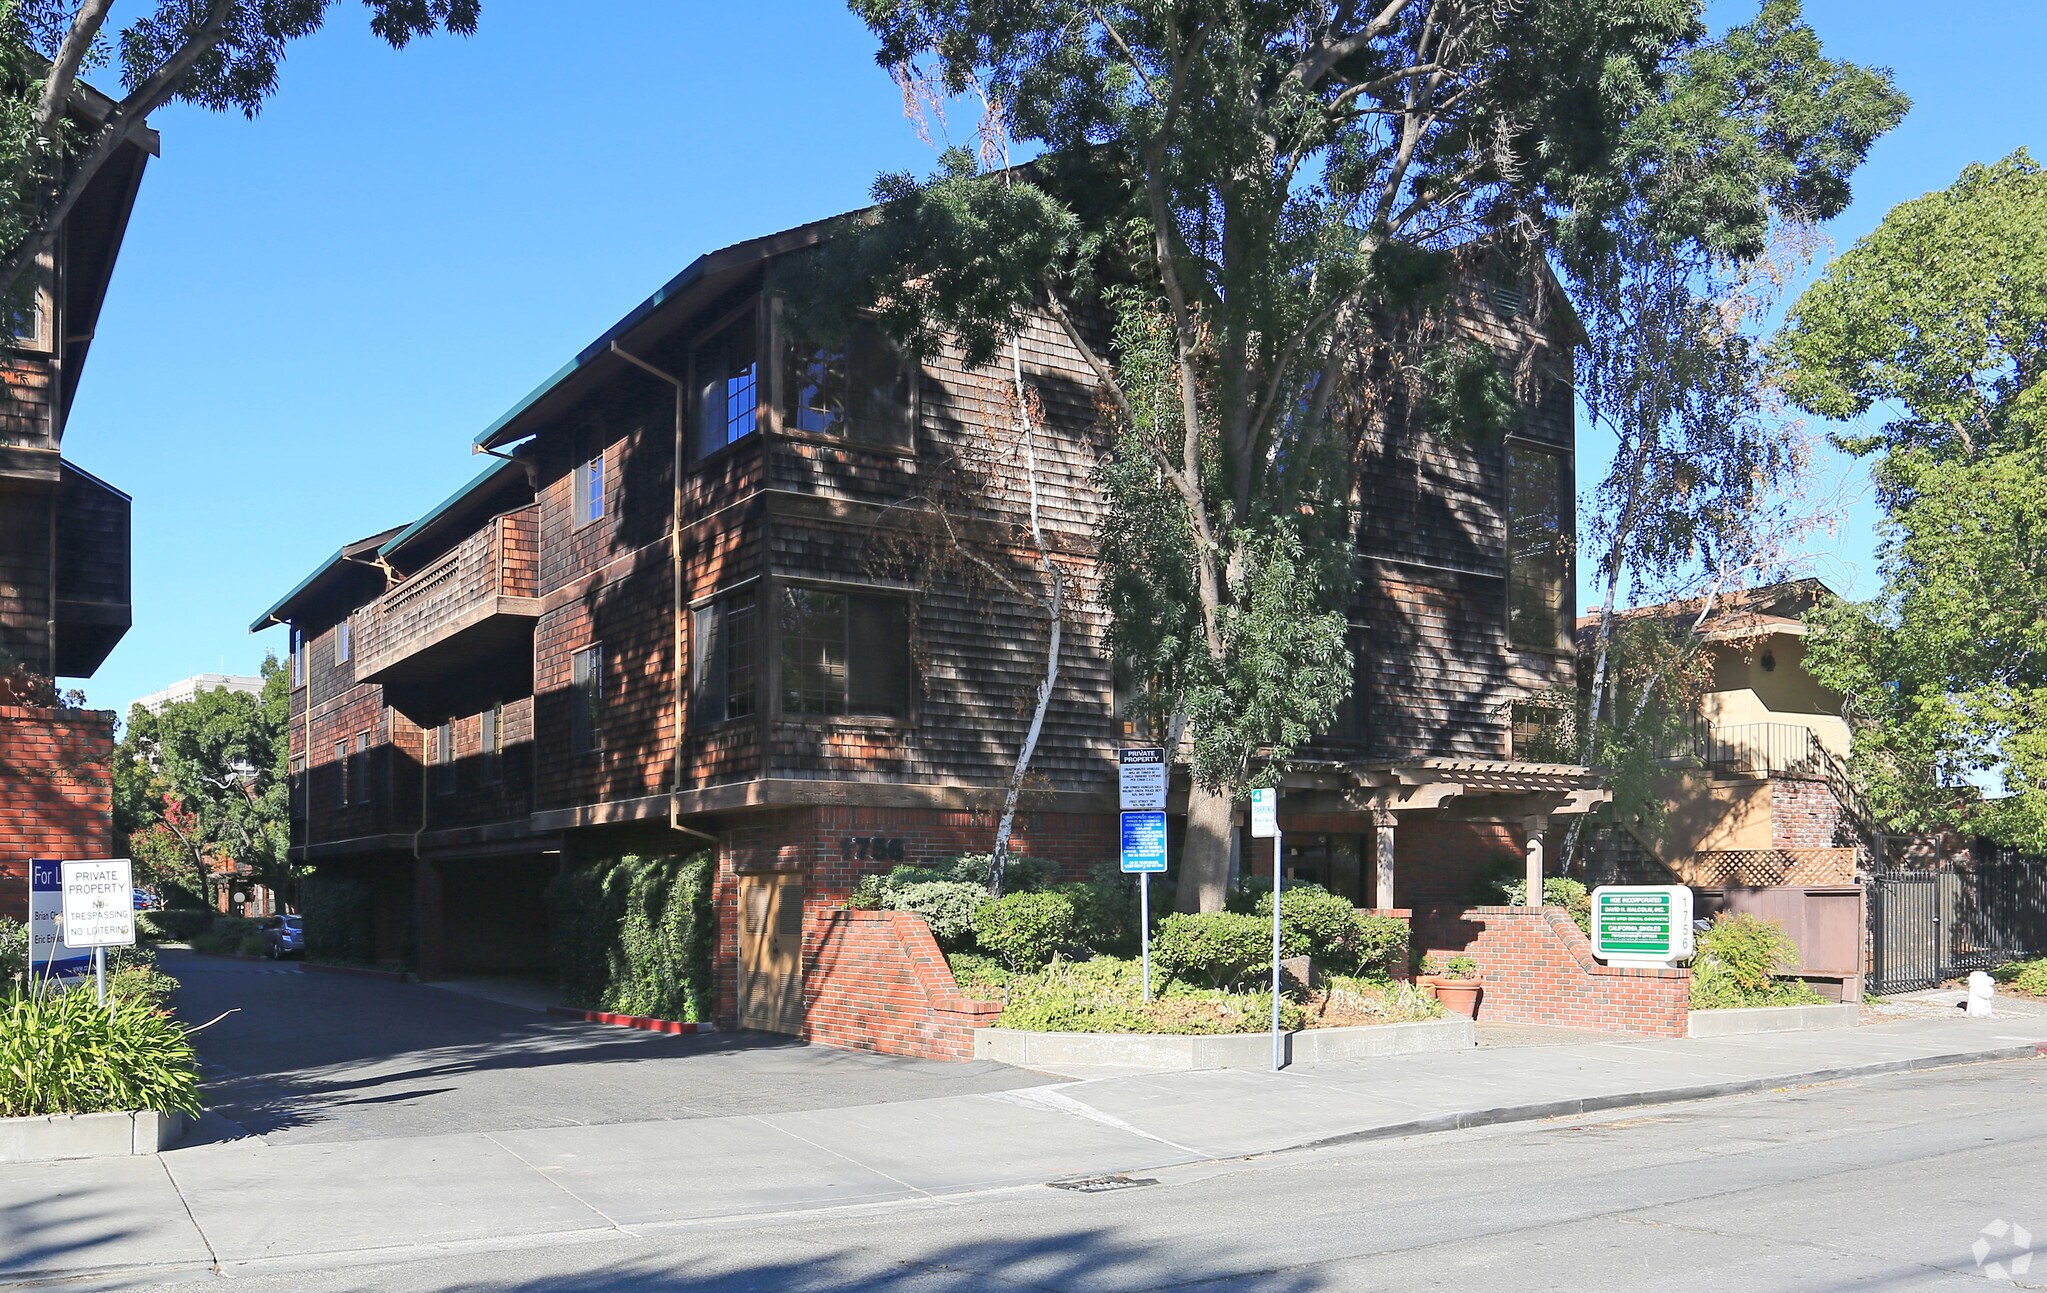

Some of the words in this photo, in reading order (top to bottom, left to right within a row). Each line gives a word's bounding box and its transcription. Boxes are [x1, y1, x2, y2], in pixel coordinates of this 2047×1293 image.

[1254, 791, 1261, 800] 4
[1254, 806, 1275, 814] PARKING
[35, 866, 52, 884] For
[76, 871, 117, 881] PRIVATE
[69, 883, 126, 894] PROPERTY
[35, 912, 48, 920] Brian
[71, 911, 128, 920] TRESPASSING
[87, 925, 129, 935] LOITERING
[35, 935, 46, 944] Eric
